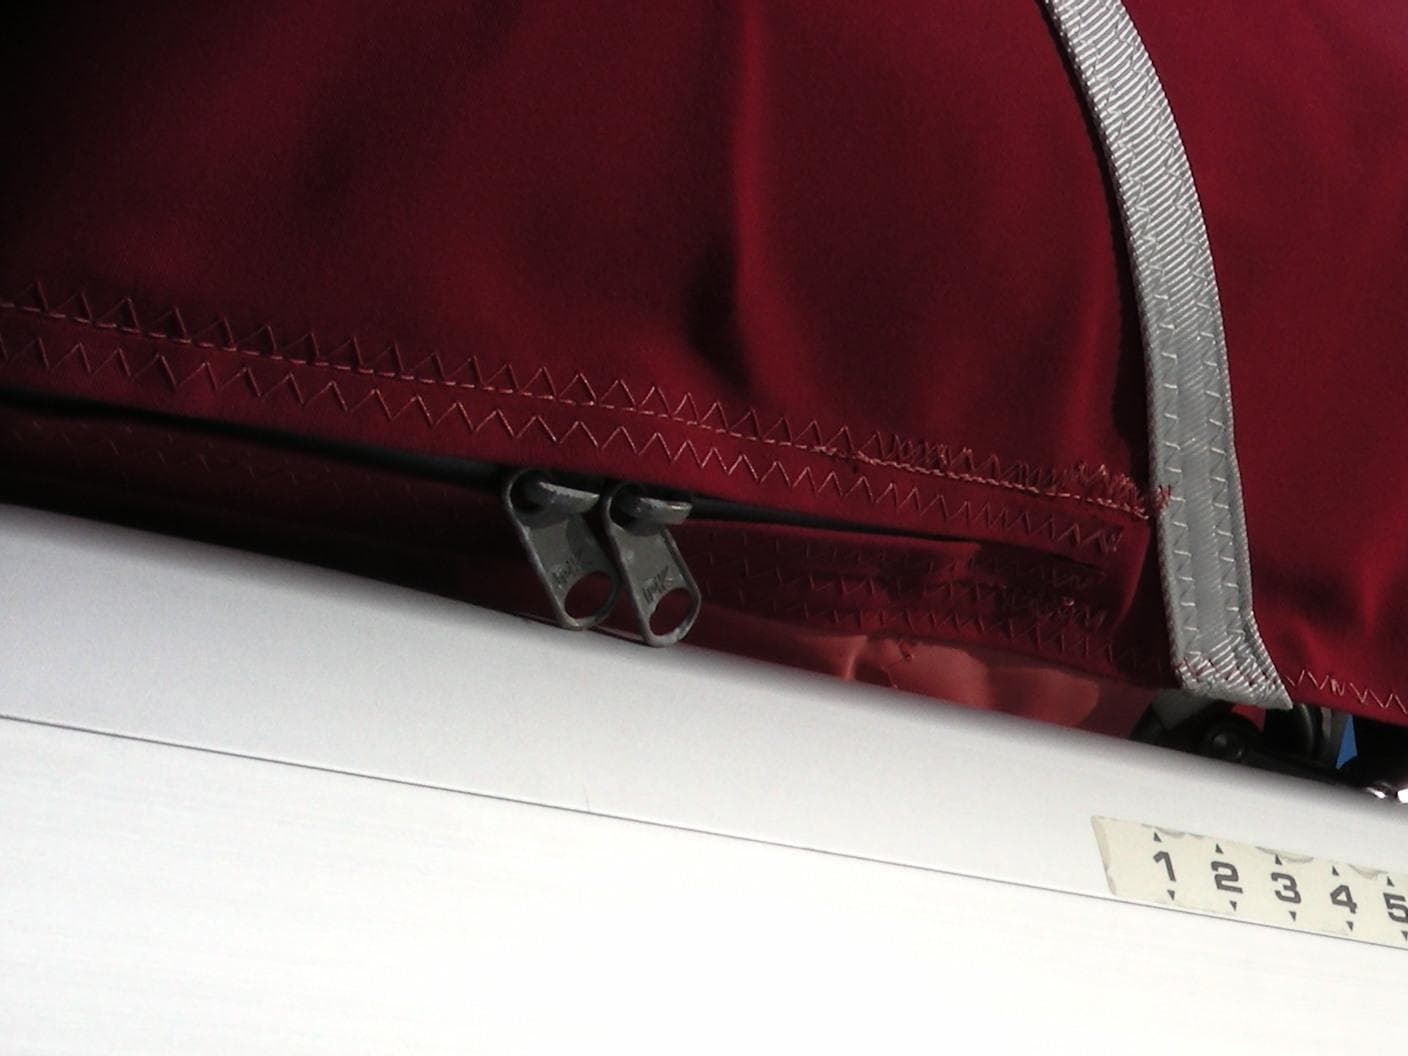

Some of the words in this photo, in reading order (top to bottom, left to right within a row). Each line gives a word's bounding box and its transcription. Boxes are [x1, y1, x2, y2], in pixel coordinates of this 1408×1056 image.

[1153, 851, 1176, 882] 1
[1210, 860, 1243, 894] 2
[1270, 872, 1302, 904] 3
[1330, 884, 1358, 914] 4
